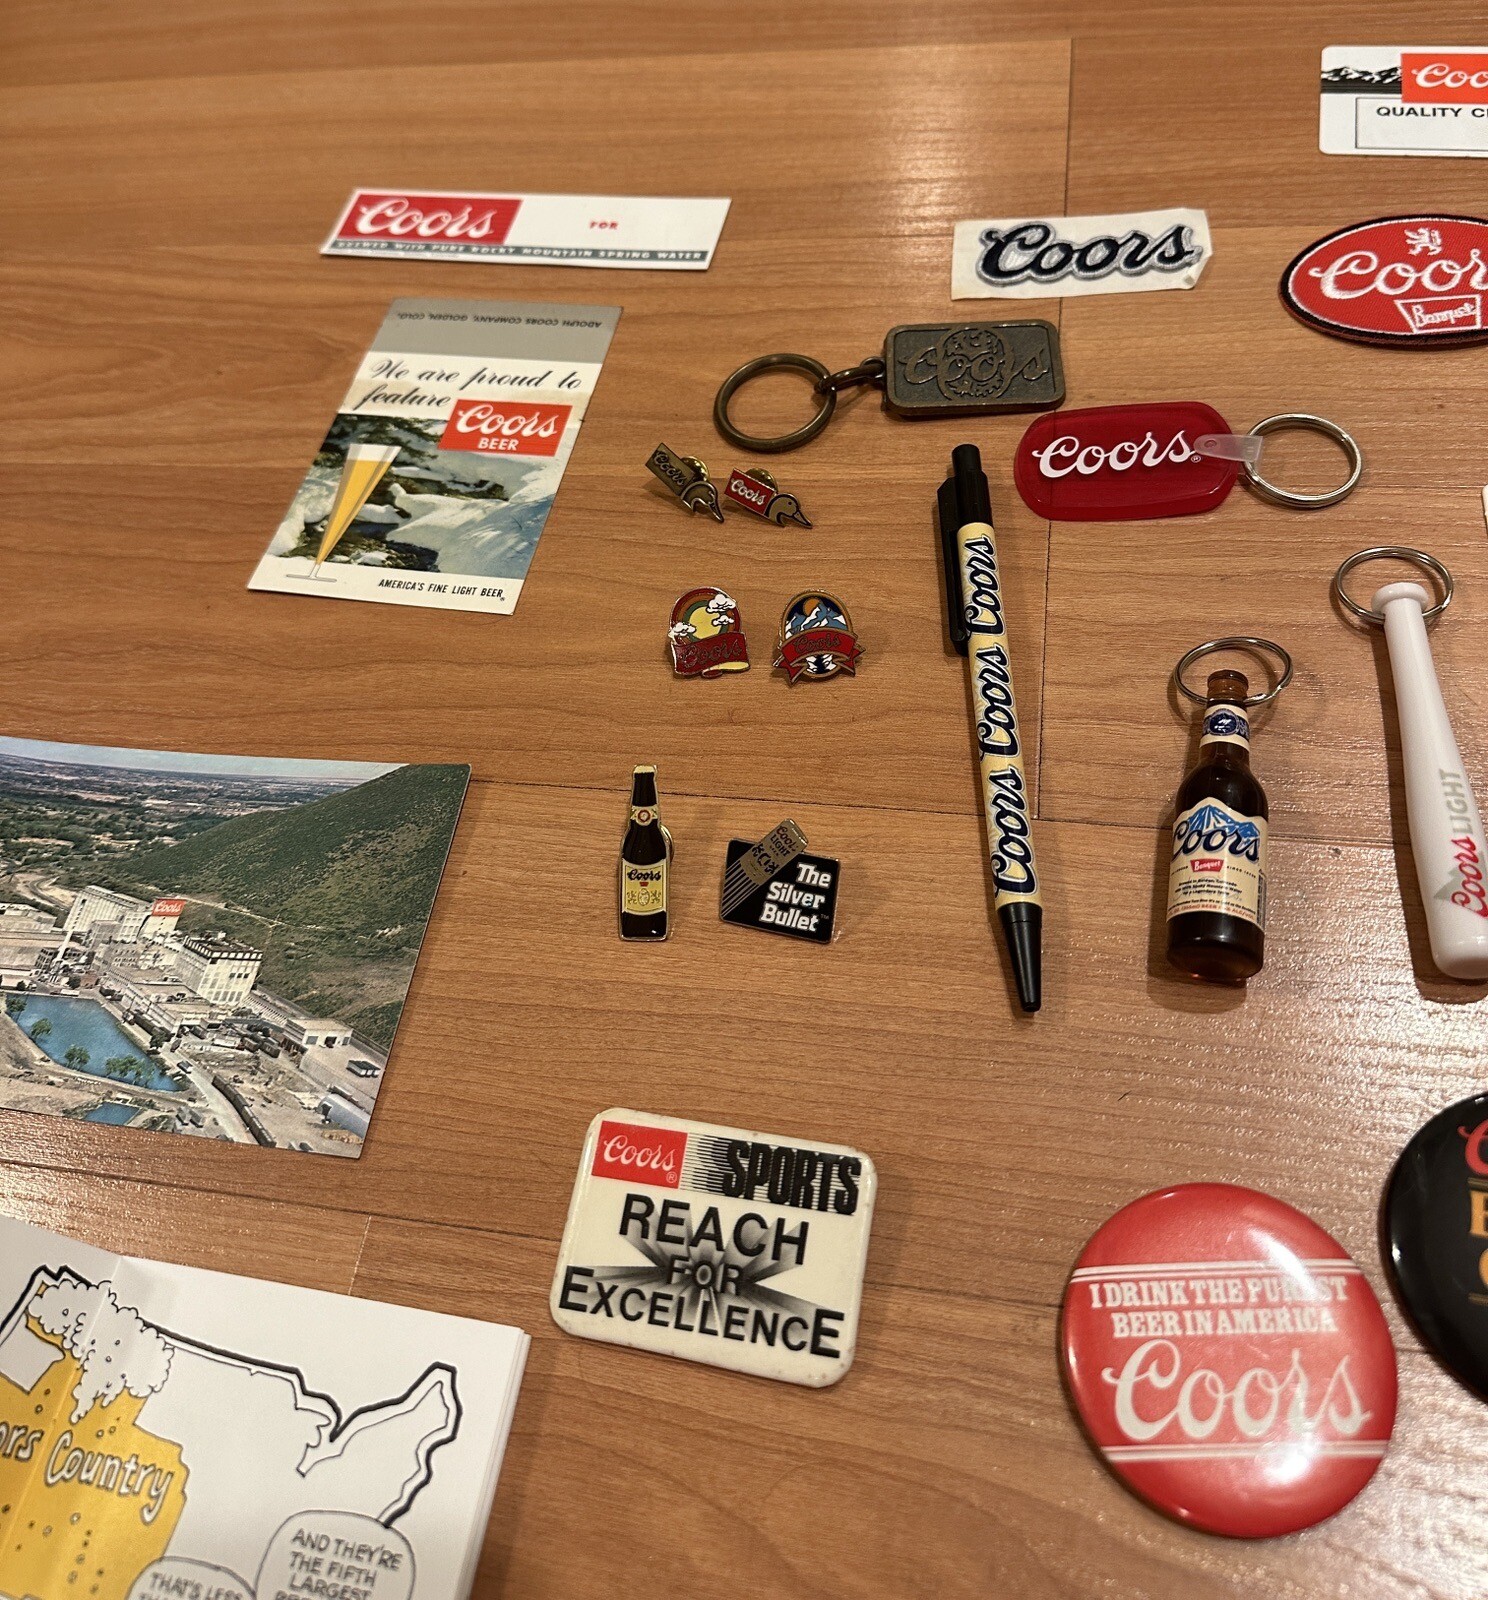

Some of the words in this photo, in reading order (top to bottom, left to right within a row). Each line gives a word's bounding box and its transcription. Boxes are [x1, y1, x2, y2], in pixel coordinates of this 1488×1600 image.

[1376, 106, 1462, 118] QUALITY
[356, 197, 498, 238] Coors
[589, 220, 619, 231] FOR
[395, 243, 426, 252] WITH
[522, 247, 593, 258] MOUNTAIN
[599, 250, 651, 259] SPRING
[657, 251, 702, 260] WATER
[976, 221, 1203, 287] Coors
[525, 317, 559, 327] COORS
[562, 319, 602, 329] ADOLPH
[371, 358, 409, 380] We
[417, 369, 460, 382] are
[459, 367, 553, 391] proud
[557, 371, 582, 389] to
[352, 383, 452, 411] feature
[458, 403, 559, 438] Coors
[477, 437, 519, 451] BEER
[1032, 430, 1196, 478] Coors
[653, 450, 685, 488] Coors
[730, 476, 766, 507] Coors
[378, 578, 425, 592] AMERICA'S
[427, 583, 449, 594] FINE
[451, 585, 478, 596] LIGHT
[480, 587, 503, 598] BEER
[962, 534, 1005, 639] Coors
[791, 632, 842, 652] Coors
[976, 644, 1021, 761] Coors
[1438, 768, 1474, 836] LIGHT
[770, 833, 791, 857] LIGHT
[989, 766, 1037, 898] Coors
[1172, 820, 1259, 863] Coors
[627, 869, 661, 881] Coors
[796, 863, 832, 888] The
[1451, 836, 1488, 918] Coors
[154, 901, 182, 913] Coors
[766, 881, 826, 910] Silver
[759, 902, 818, 932] Bullet
[604, 1134, 676, 1172] Coors
[722, 1140, 862, 1216] SPORTS
[619, 1192, 810, 1265] REACH
[666, 1255, 743, 1296] FOR
[1089, 1283, 1103, 1309] I
[1103, 1280, 1189, 1307] DRINK
[1189, 1278, 1243, 1305] THE
[1244, 1276, 1348, 1302] PURST
[558, 1265, 845, 1359] EXCELLENCE
[1110, 1310, 1184, 1338] BEER
[1183, 1309, 1214, 1336] IN
[1216, 1306, 1340, 1335] AMERICA
[1102, 1339, 1374, 1442] Coors
[44, 1429, 176, 1526] Country
[291, 1528, 330, 1552] AND
[333, 1537, 403, 1572] THEY'RE
[150, 1572, 203, 1600] THAT'S
[289, 1551, 323, 1575] THE
[327, 1560, 378, 1588] FIFTH
[289, 1572, 373, 1600] LARGEST
